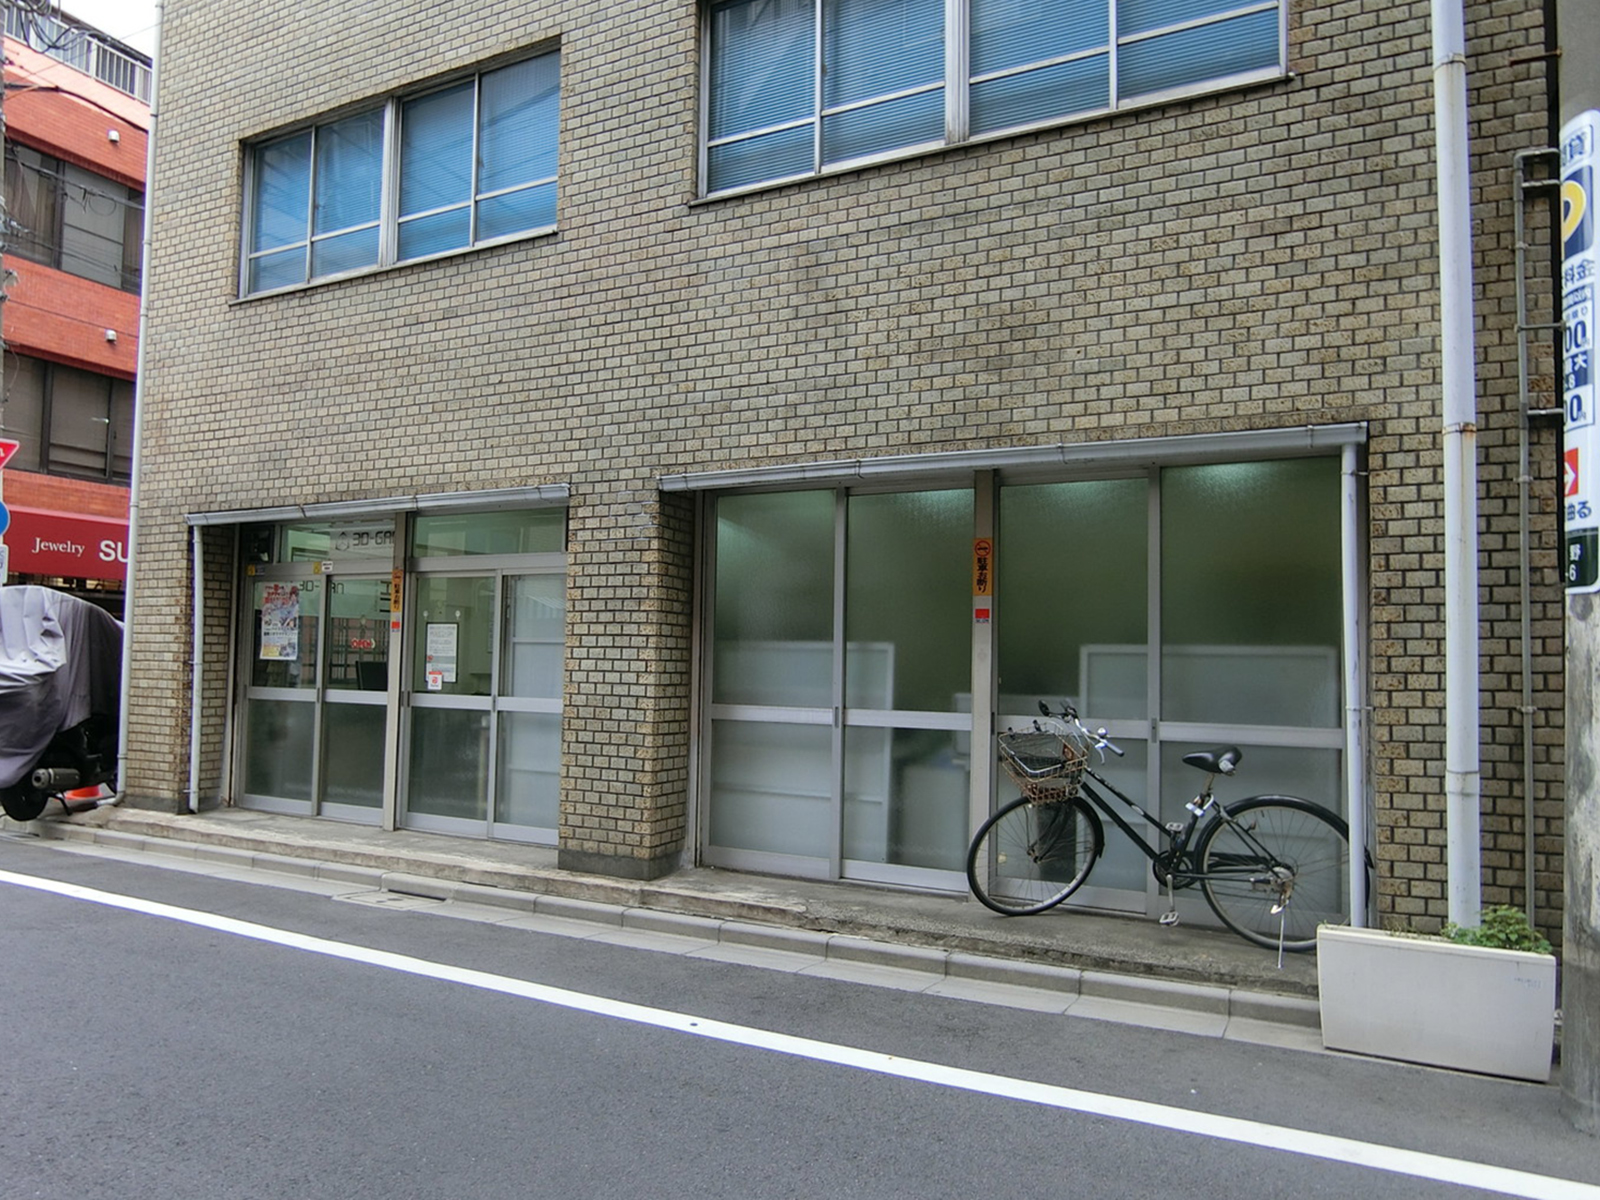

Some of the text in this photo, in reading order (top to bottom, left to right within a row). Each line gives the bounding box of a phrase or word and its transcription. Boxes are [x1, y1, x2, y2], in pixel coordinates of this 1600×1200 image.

[32, 537, 85, 557] Jewelry
[976, 557, 988, 593] 駐車お断り
